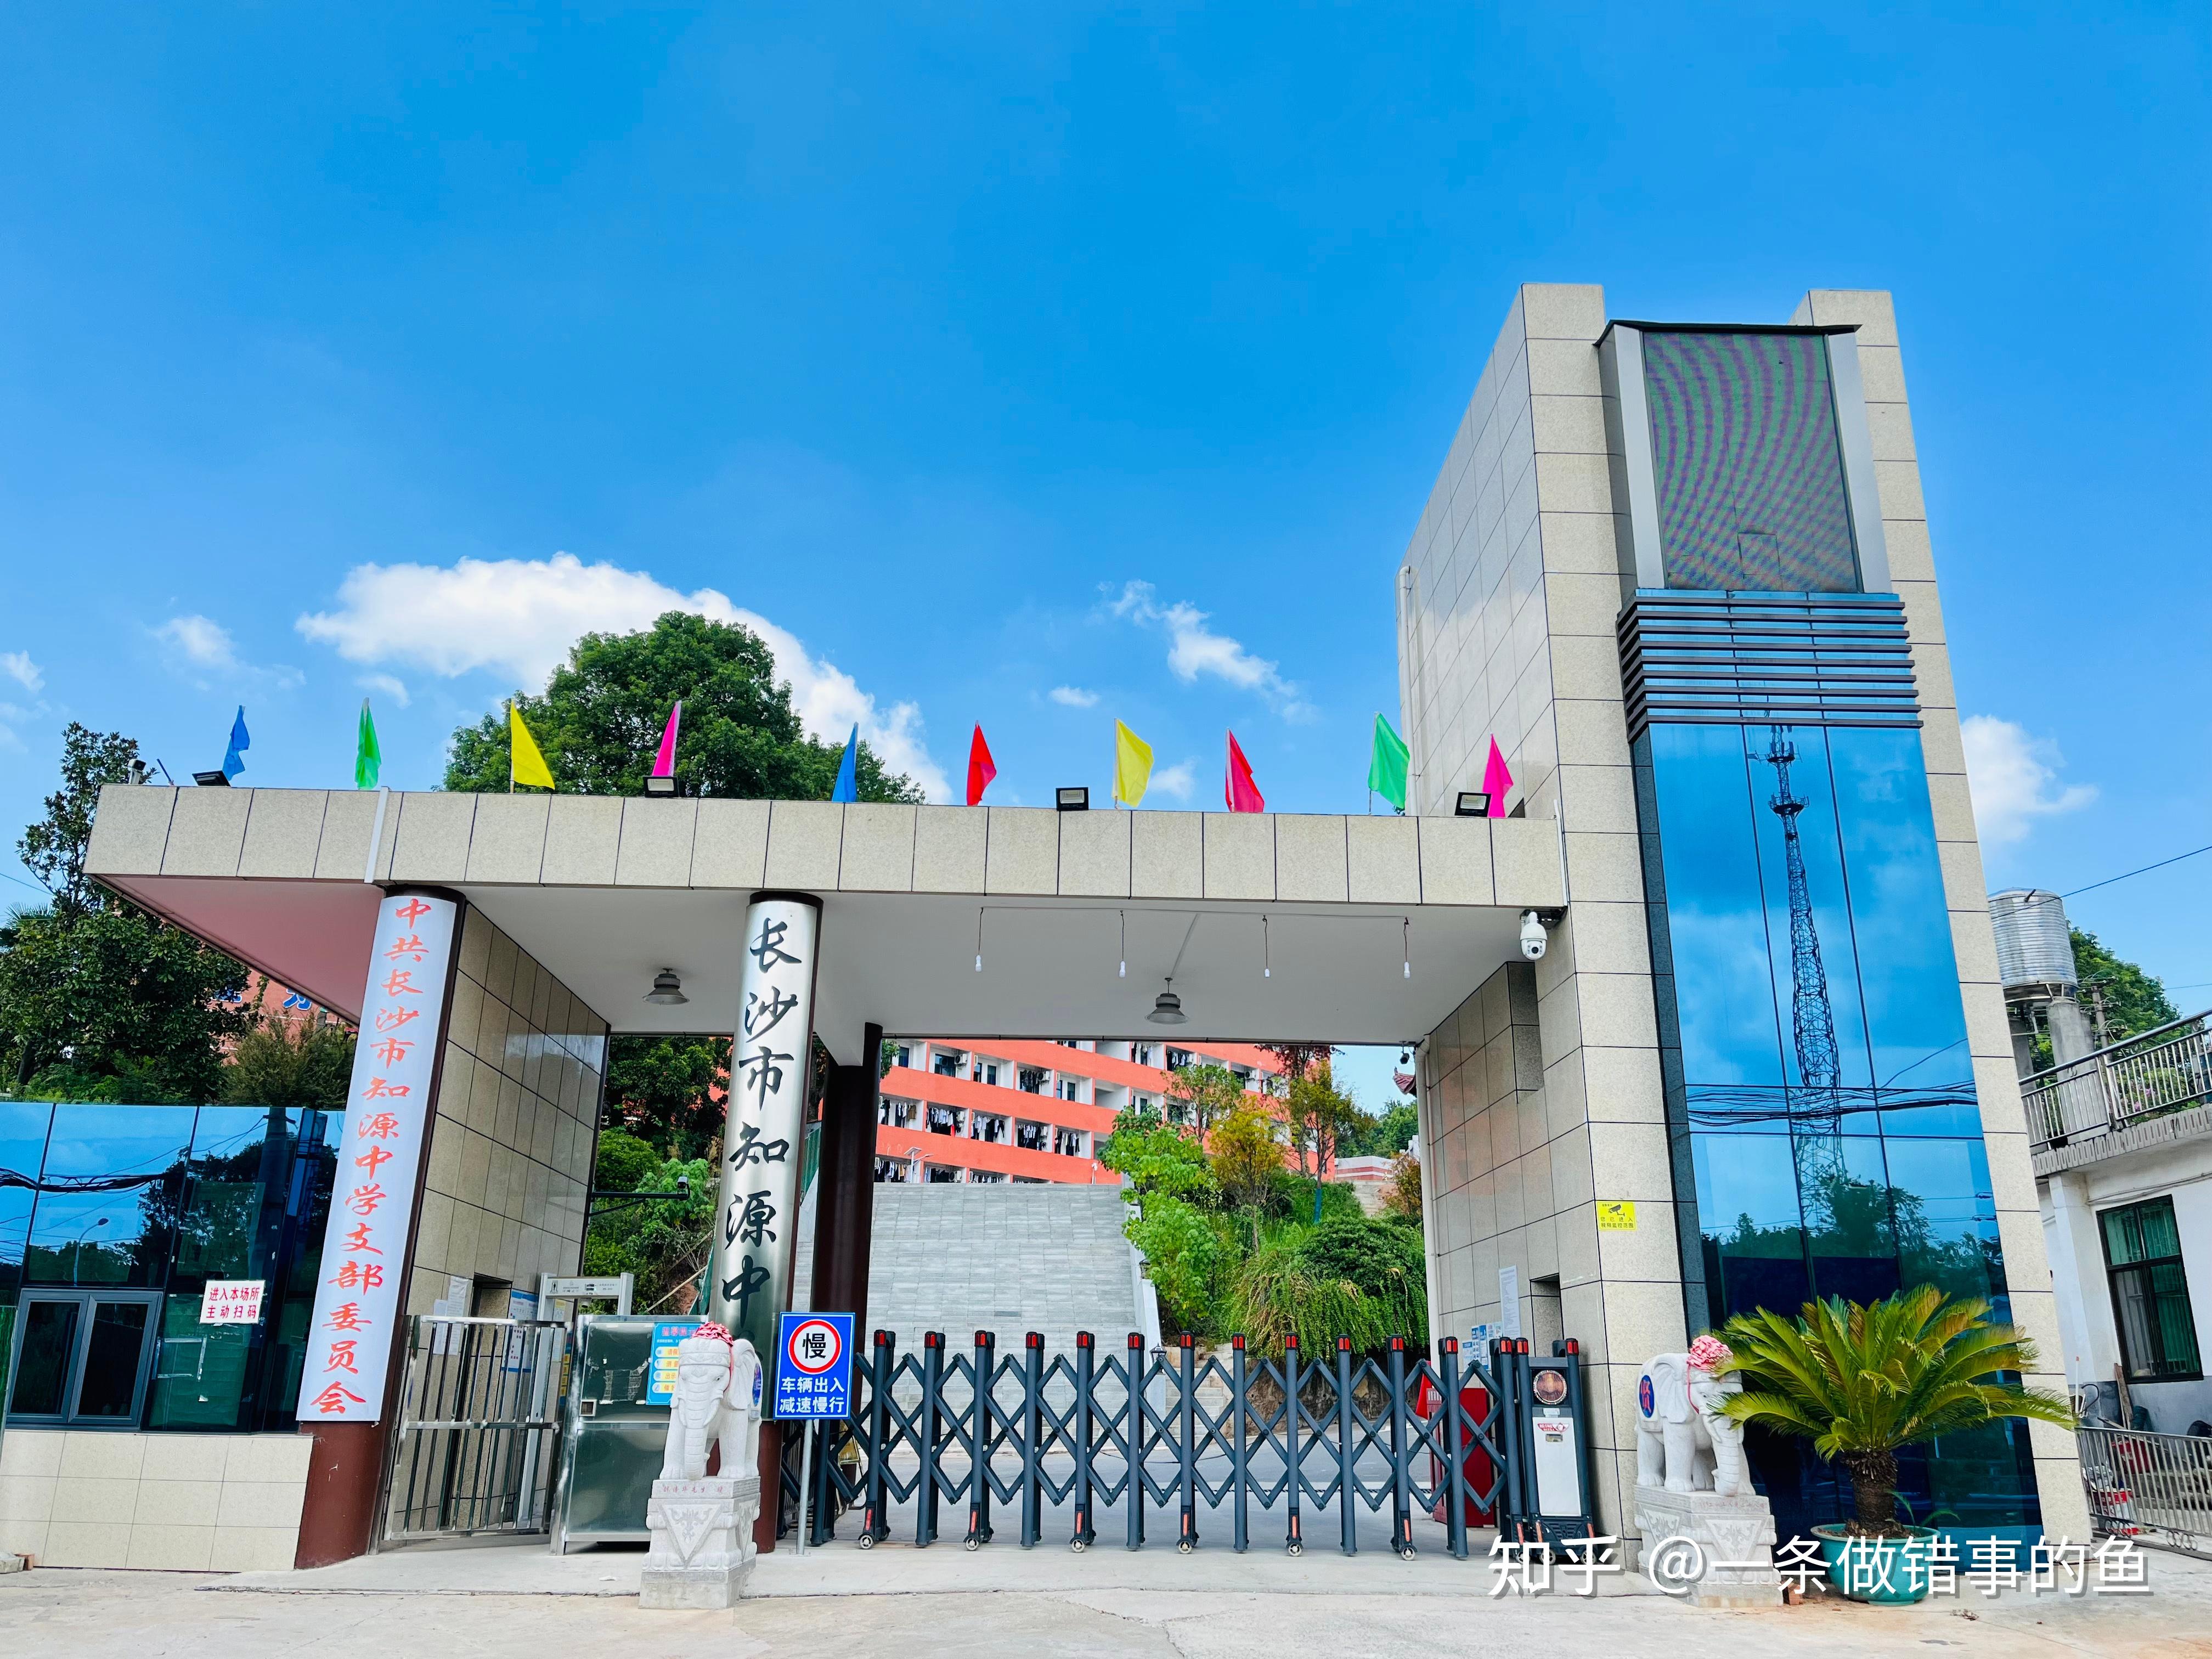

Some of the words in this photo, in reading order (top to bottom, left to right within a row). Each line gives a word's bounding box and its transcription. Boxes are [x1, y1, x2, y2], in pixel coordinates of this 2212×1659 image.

[721, 917, 803, 1362] 长沙市知源中
[310, 898, 432, 1414] 中共长沙市知源中学支部委员会
[208, 1287, 260, 1301] 进入本场所
[206, 1304, 257, 1319] 主动扫码
[802, 1333, 826, 1359] 慢
[781, 1377, 845, 1393] 车辆出入
[779, 1397, 844, 1414] 减速慢行
